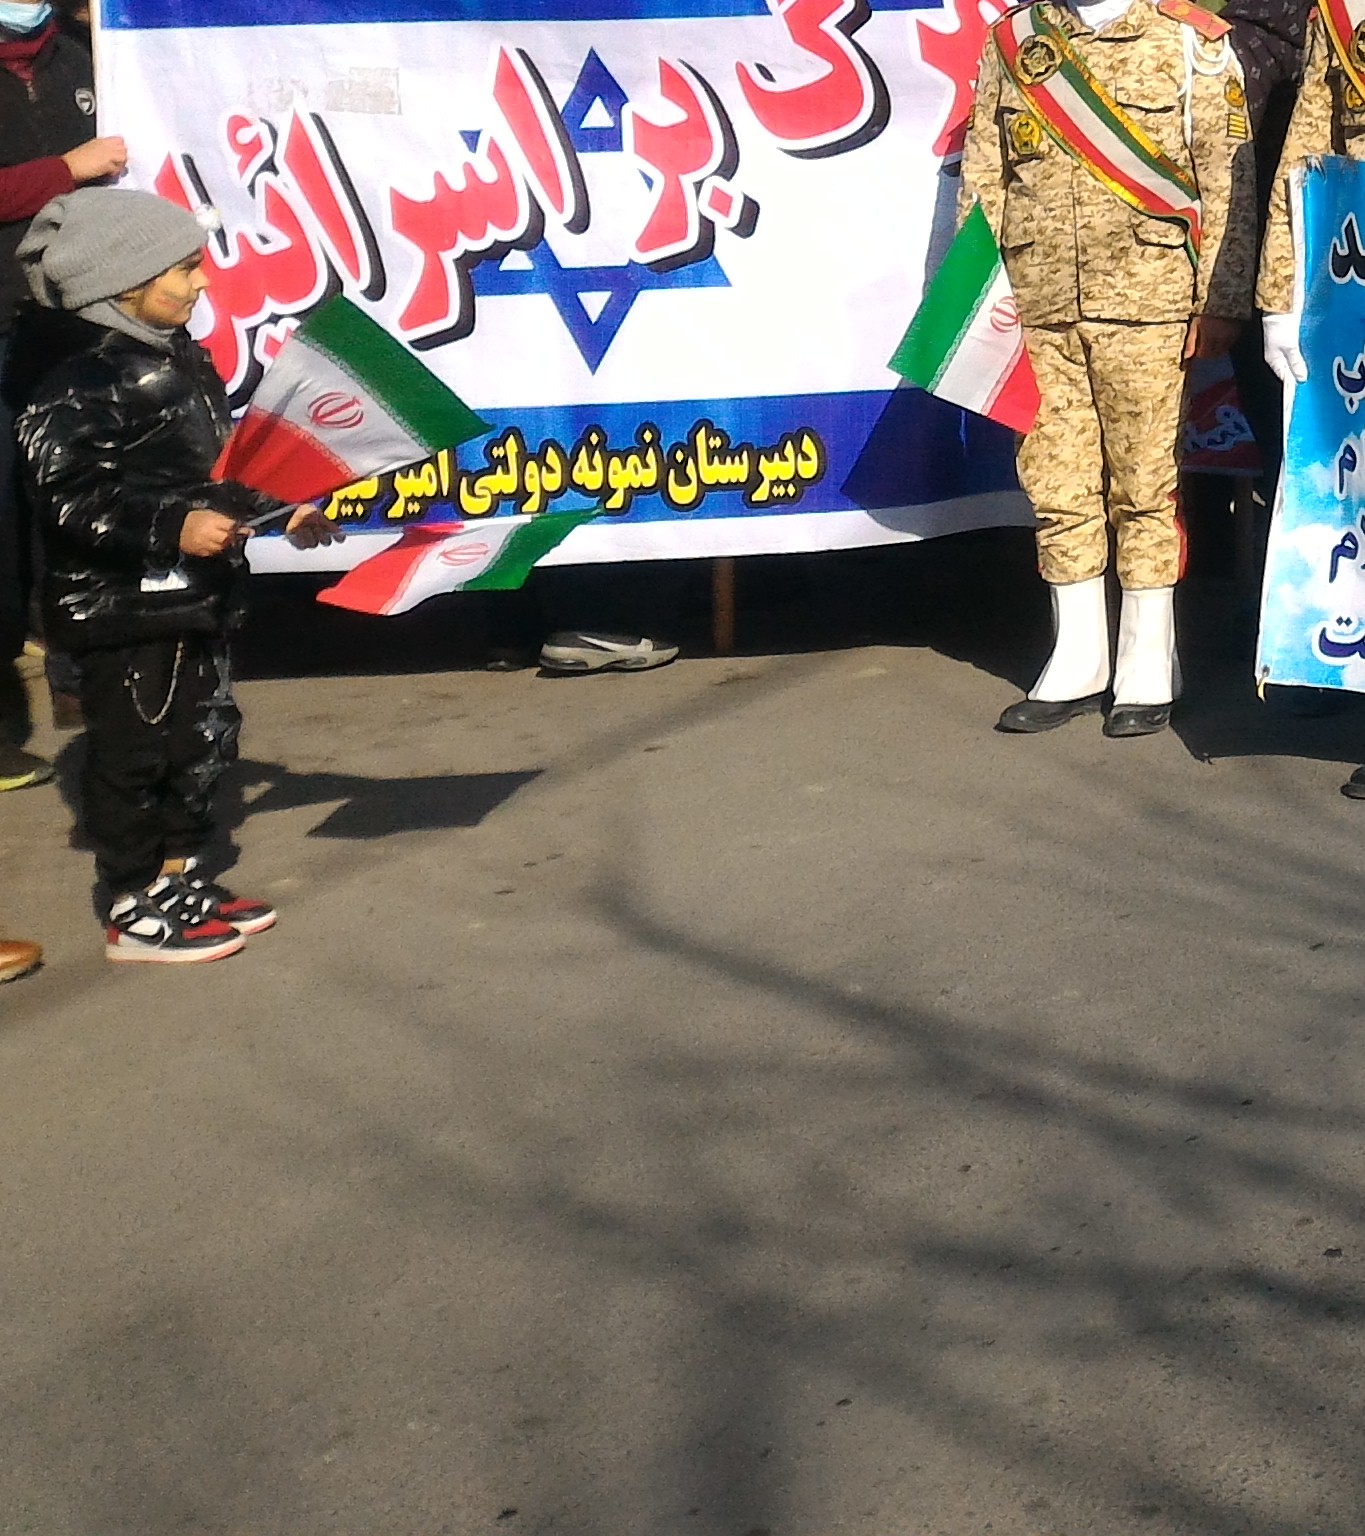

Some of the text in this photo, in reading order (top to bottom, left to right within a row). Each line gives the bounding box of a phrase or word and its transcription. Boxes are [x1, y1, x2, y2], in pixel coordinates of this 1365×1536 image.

[323, 476, 379, 521] بیر
[386, 449, 450, 520] امیر
[459, 434, 562, 515] دولتی
[571, 428, 658, 510] نمونه
